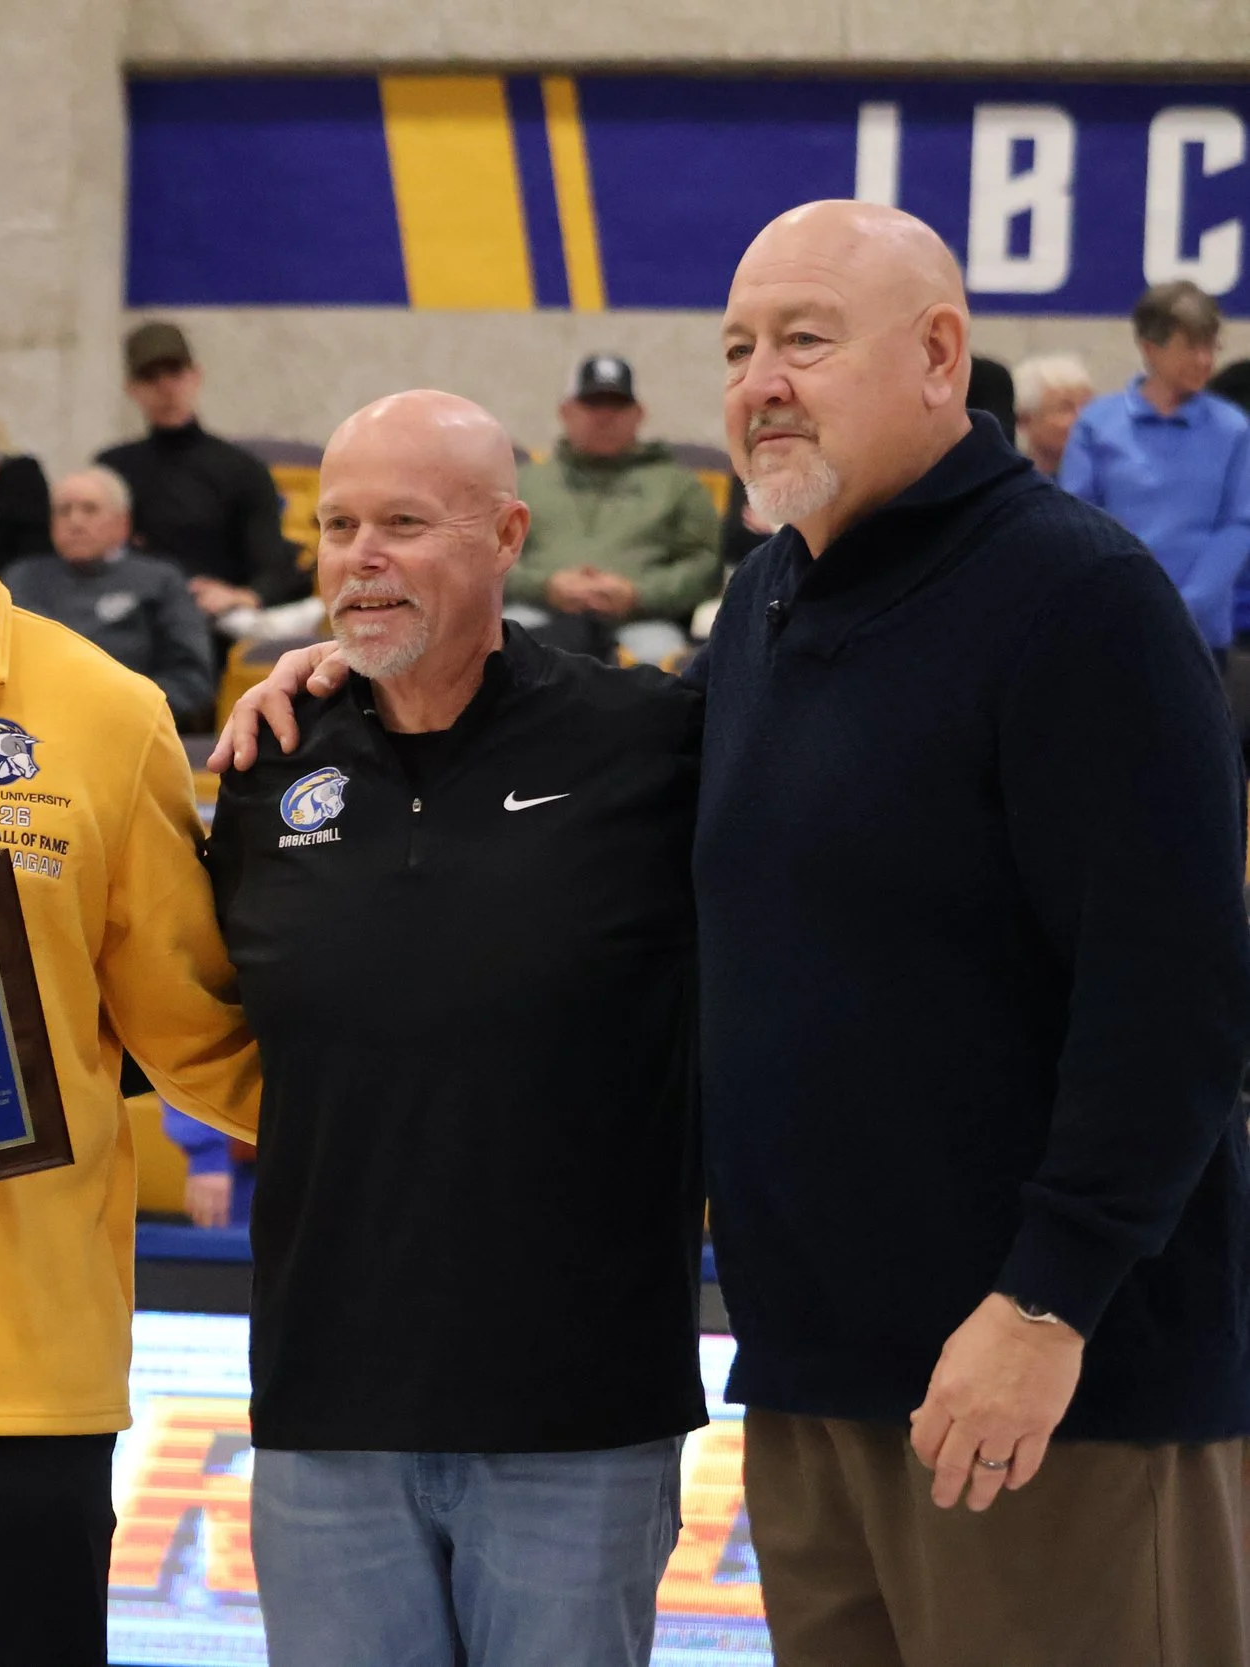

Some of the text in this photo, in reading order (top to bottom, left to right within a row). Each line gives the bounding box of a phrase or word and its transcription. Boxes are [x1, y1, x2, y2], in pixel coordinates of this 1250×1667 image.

[0, 790, 71, 808] UNIVERSITY
[20, 832, 38, 847] OF
[39, 835, 69, 855] FAME
[278, 827, 342, 848] BASKETBALL
